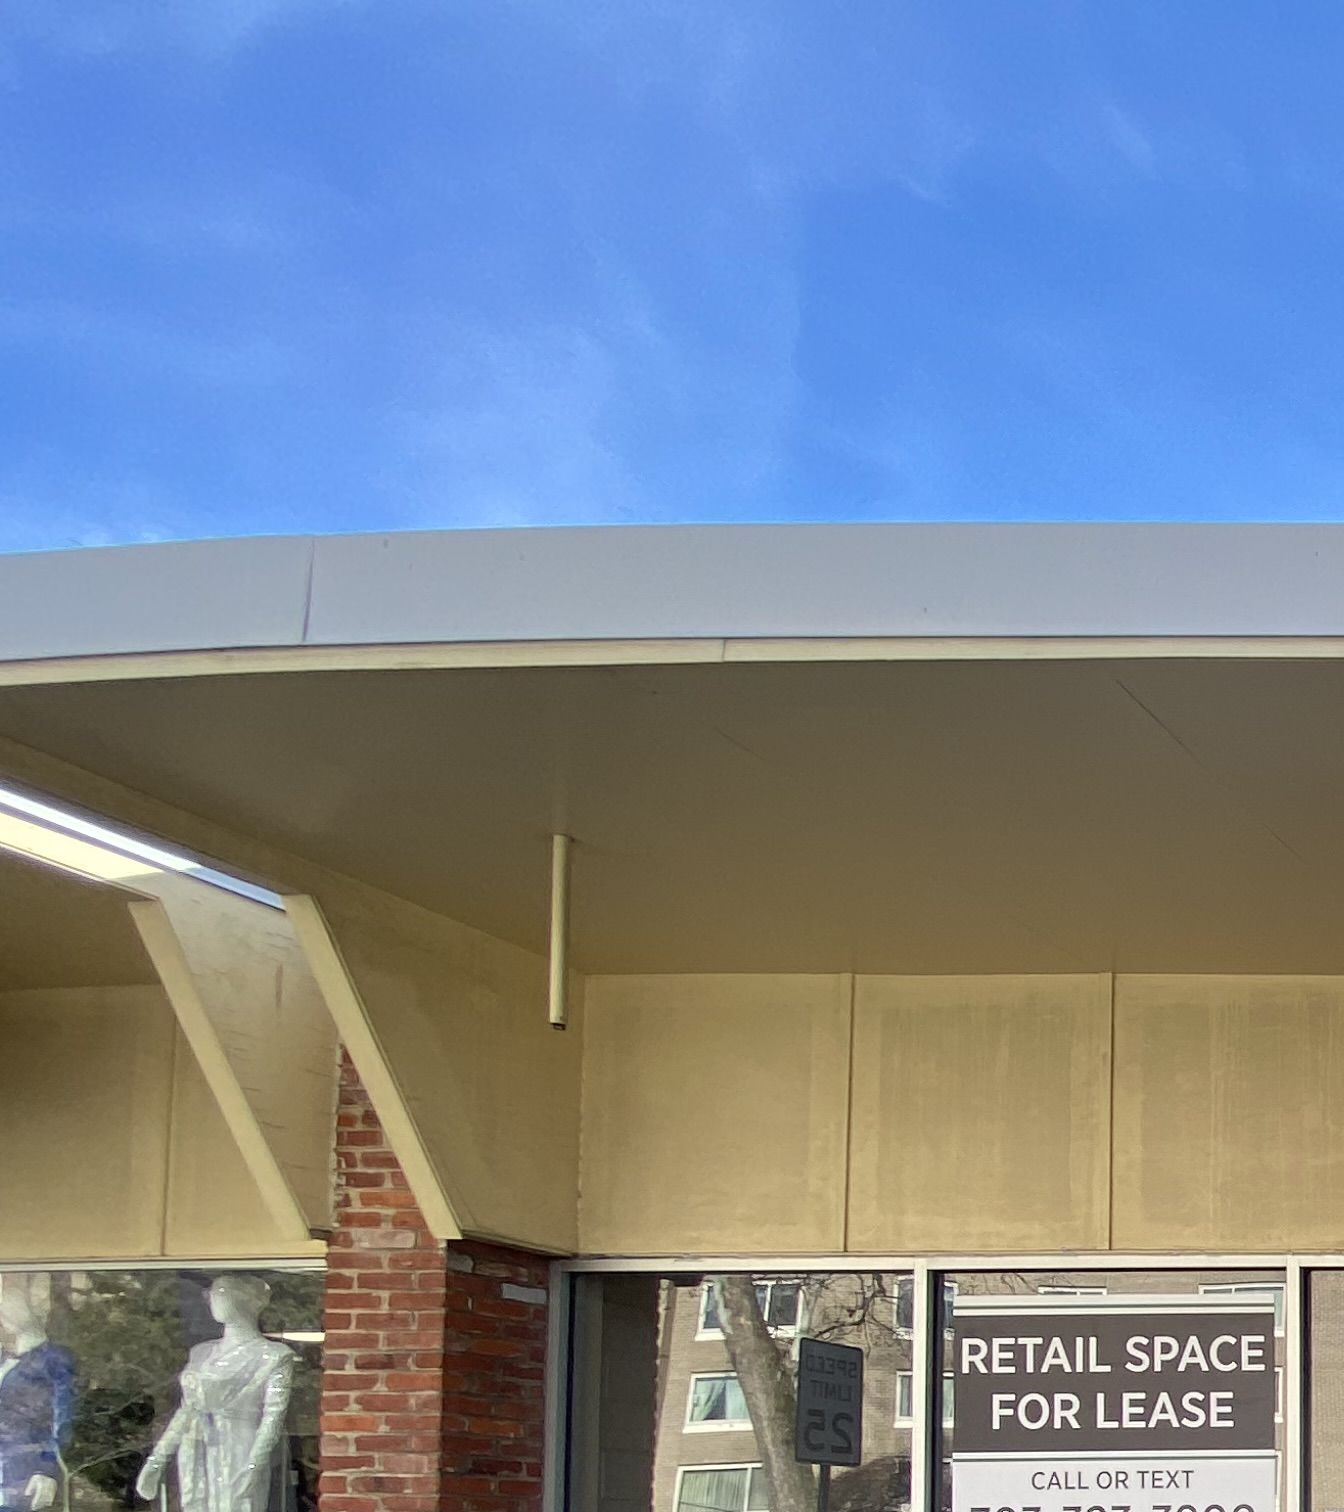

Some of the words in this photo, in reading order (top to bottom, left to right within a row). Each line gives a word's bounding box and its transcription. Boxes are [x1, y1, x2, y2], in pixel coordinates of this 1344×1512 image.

[960, 1336, 1112, 1375] RETAIL
[1124, 1334, 1267, 1373] SPACE
[991, 1392, 1082, 1430] FOR
[1095, 1391, 1236, 1429] LEASE
[1030, 1470, 1090, 1491] CALL
[1096, 1470, 1130, 1490] OR
[1136, 1469, 1195, 1490] TEXT
